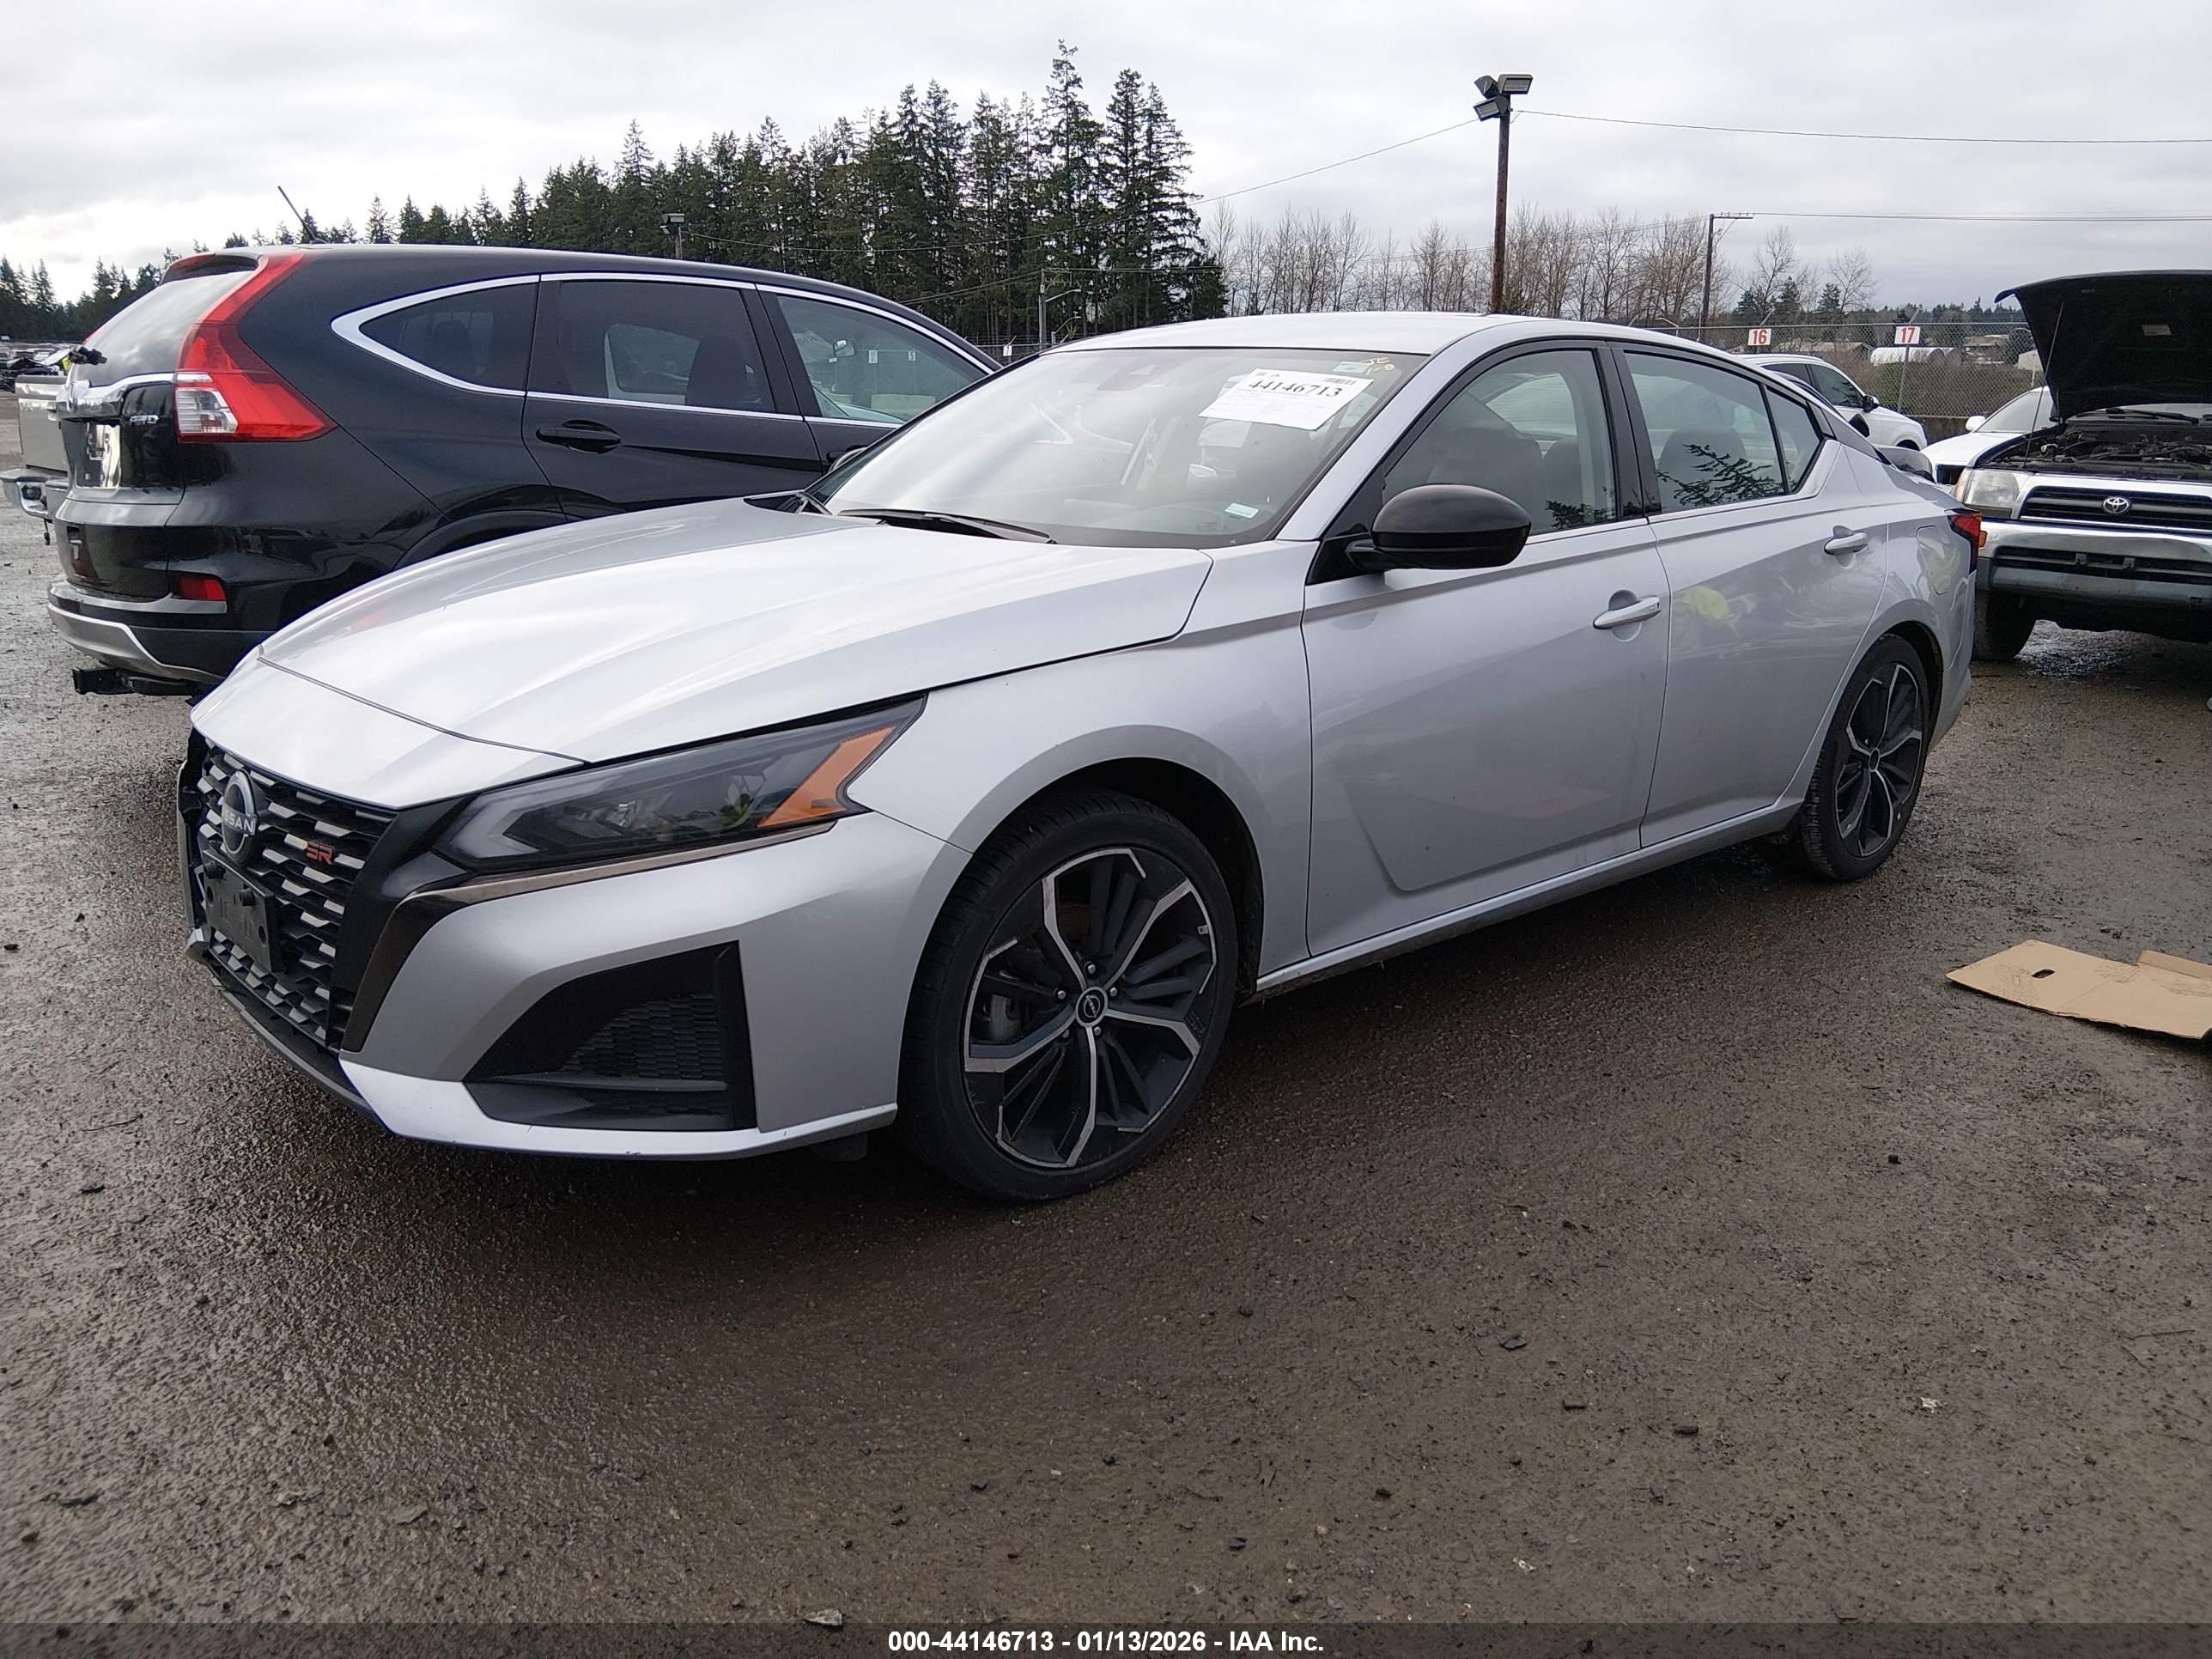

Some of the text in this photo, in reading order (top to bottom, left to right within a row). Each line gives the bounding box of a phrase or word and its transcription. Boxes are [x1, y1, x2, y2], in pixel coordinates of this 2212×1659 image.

[1753, 329, 1768, 345] 16
[1901, 327, 1916, 343] 17
[1248, 379, 1344, 398] 44146713
[222, 810, 254, 834] SSAN
[307, 840, 334, 865] SR
